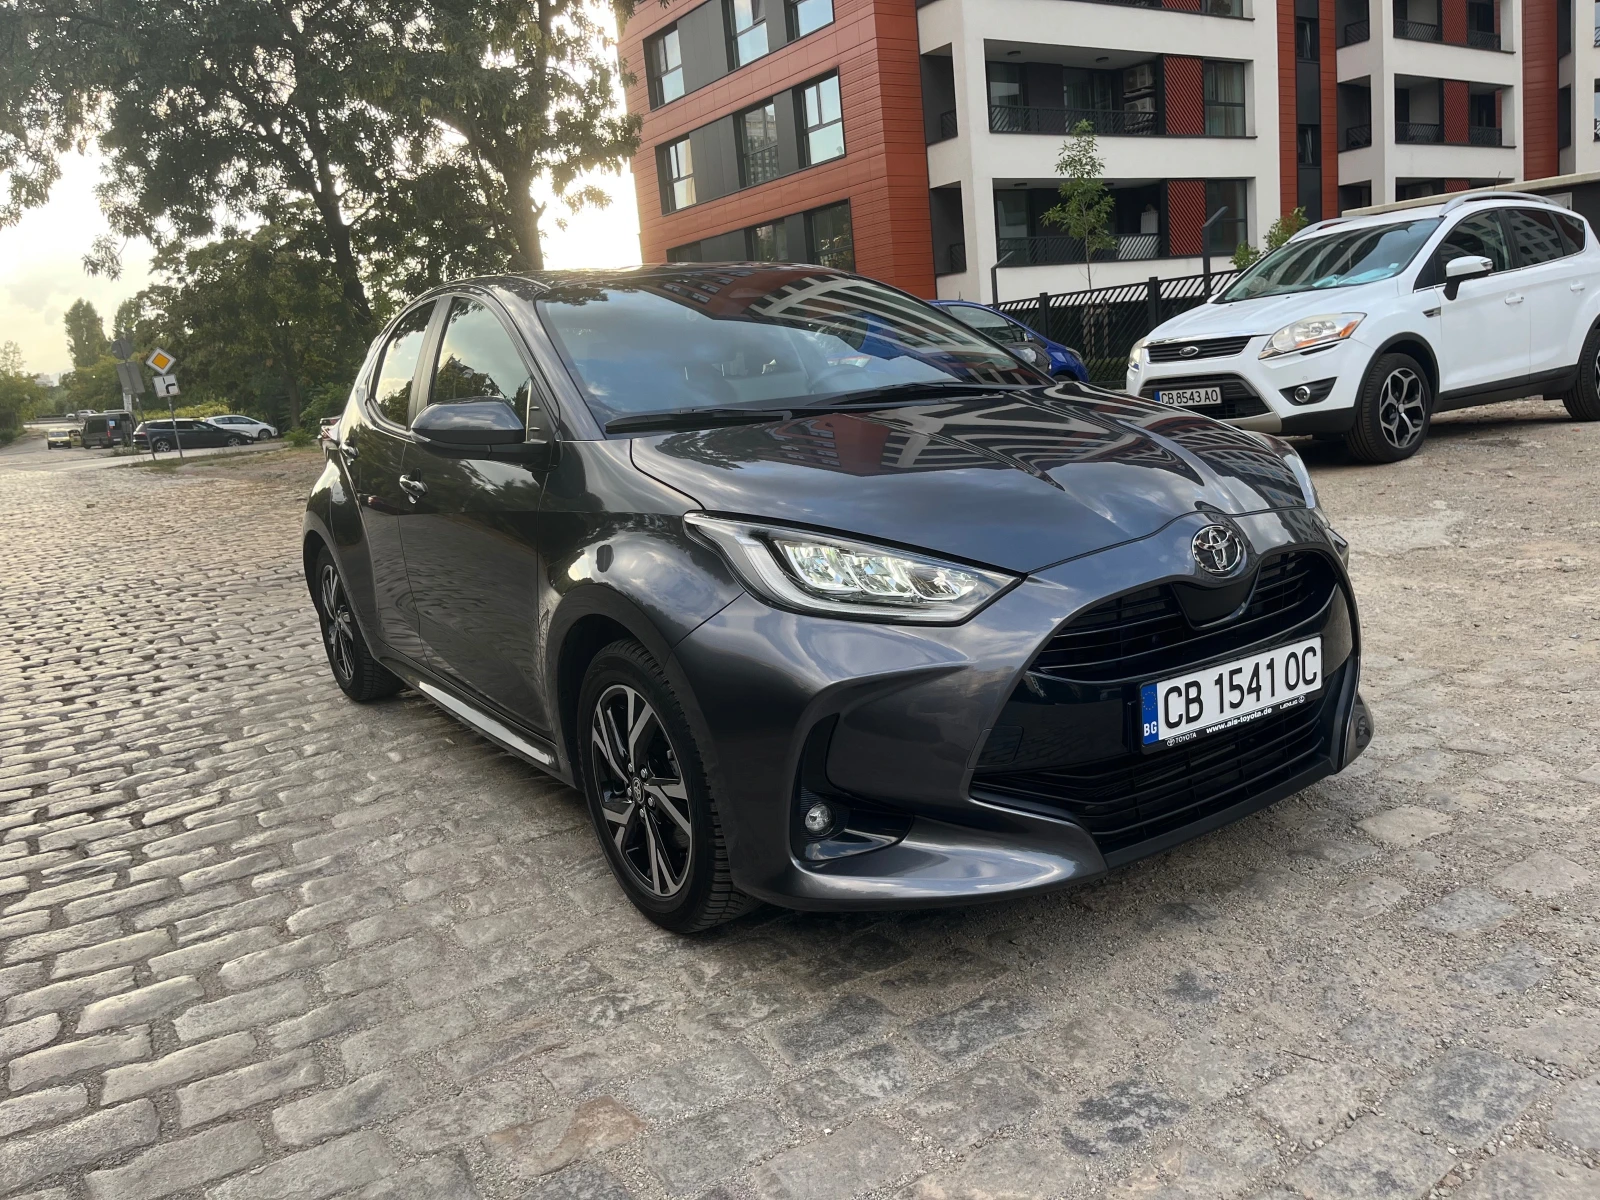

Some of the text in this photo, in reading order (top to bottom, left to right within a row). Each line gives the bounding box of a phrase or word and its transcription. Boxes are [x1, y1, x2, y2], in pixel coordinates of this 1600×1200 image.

[1161, 389, 1219, 405] CB 8543 AO
[1164, 645, 1317, 729] CB 1541 OC
[1143, 720, 1158, 737] BG
[1205, 707, 1273, 734] www.ais-toyota.de
[1175, 732, 1197, 744] TOYOTA
